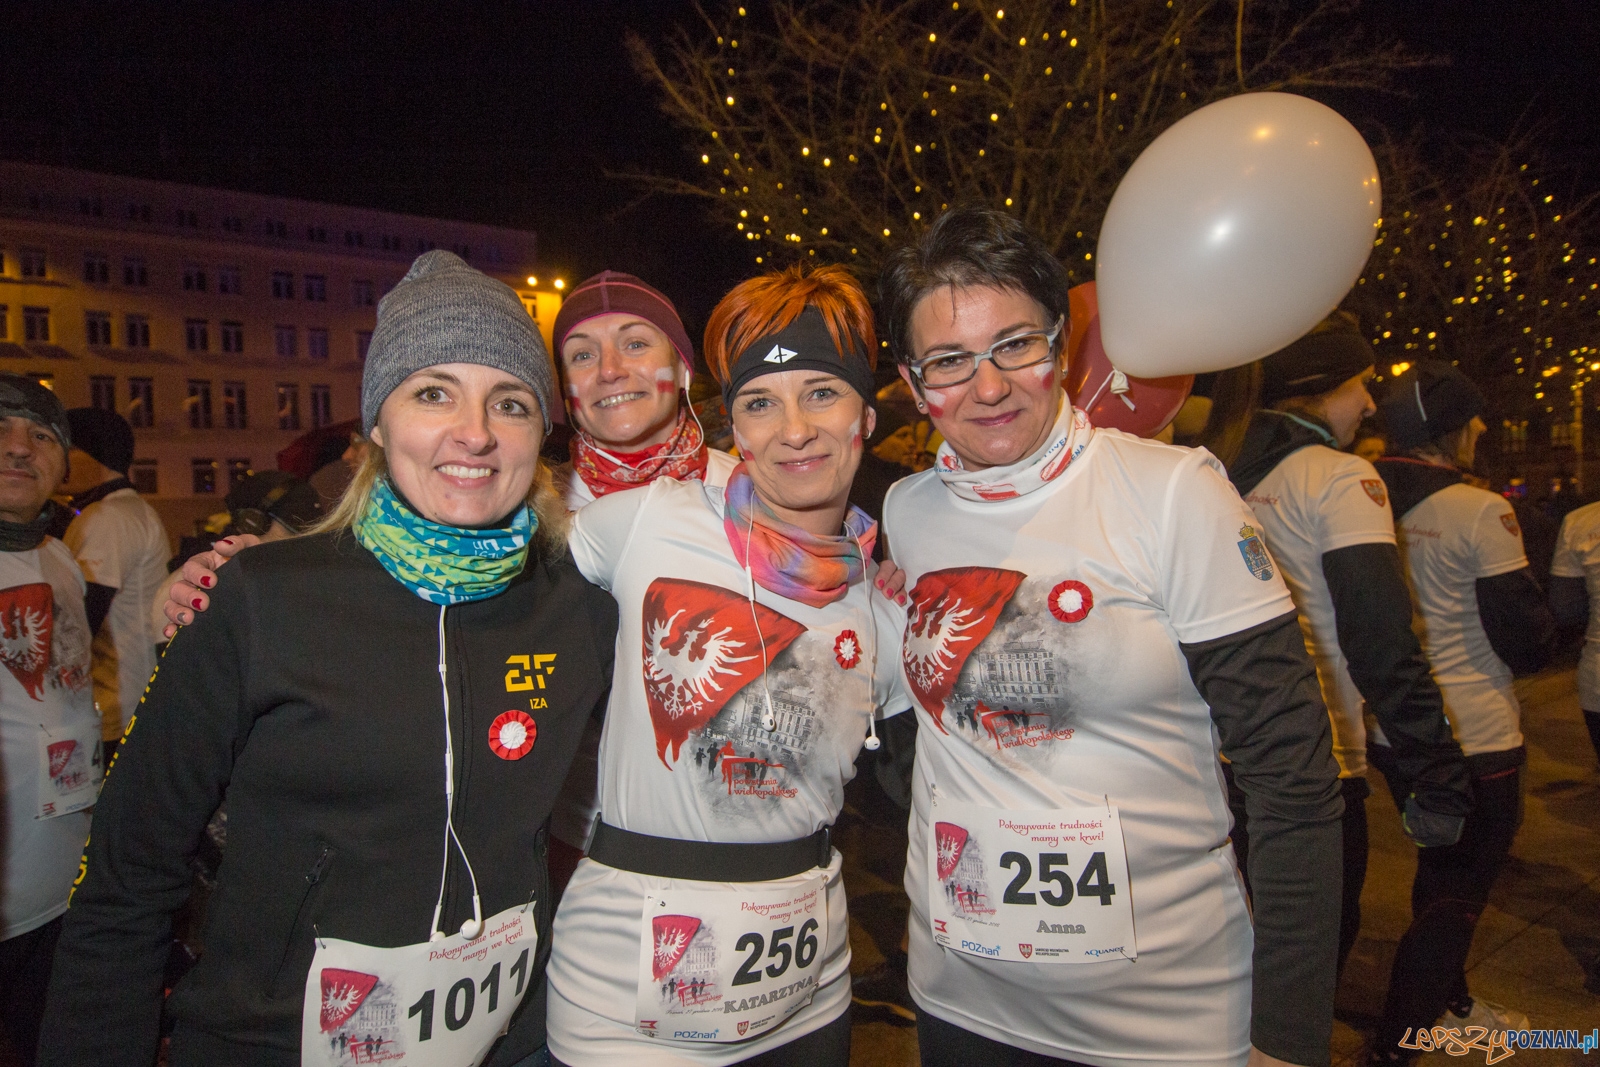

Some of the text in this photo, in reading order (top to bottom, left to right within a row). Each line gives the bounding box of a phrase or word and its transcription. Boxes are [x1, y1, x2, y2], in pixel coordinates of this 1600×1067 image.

[529, 697, 548, 710] IZA
[999, 723, 1047, 741] powstania
[1003, 727, 1075, 749] wielkopolskiego
[733, 777, 778, 788] powstania
[734, 786, 799, 800] wielkopolskiego
[998, 819, 1103, 836] Pokonywanie trudności
[1031, 831, 1105, 848] mamy we krwi!
[1000, 851, 1116, 907] 254
[741, 888, 817, 916] Pokonywanie trudności
[769, 899, 817, 923] mamy we krwi!
[429, 915, 522, 961] Pokonywanie trudności
[1036, 919, 1087, 935] Anna
[462, 926, 524, 962] mamy we krwi!
[731, 917, 819, 987] 256
[408, 947, 529, 1042] 1011
[723, 975, 815, 1014] KATARZYNA
